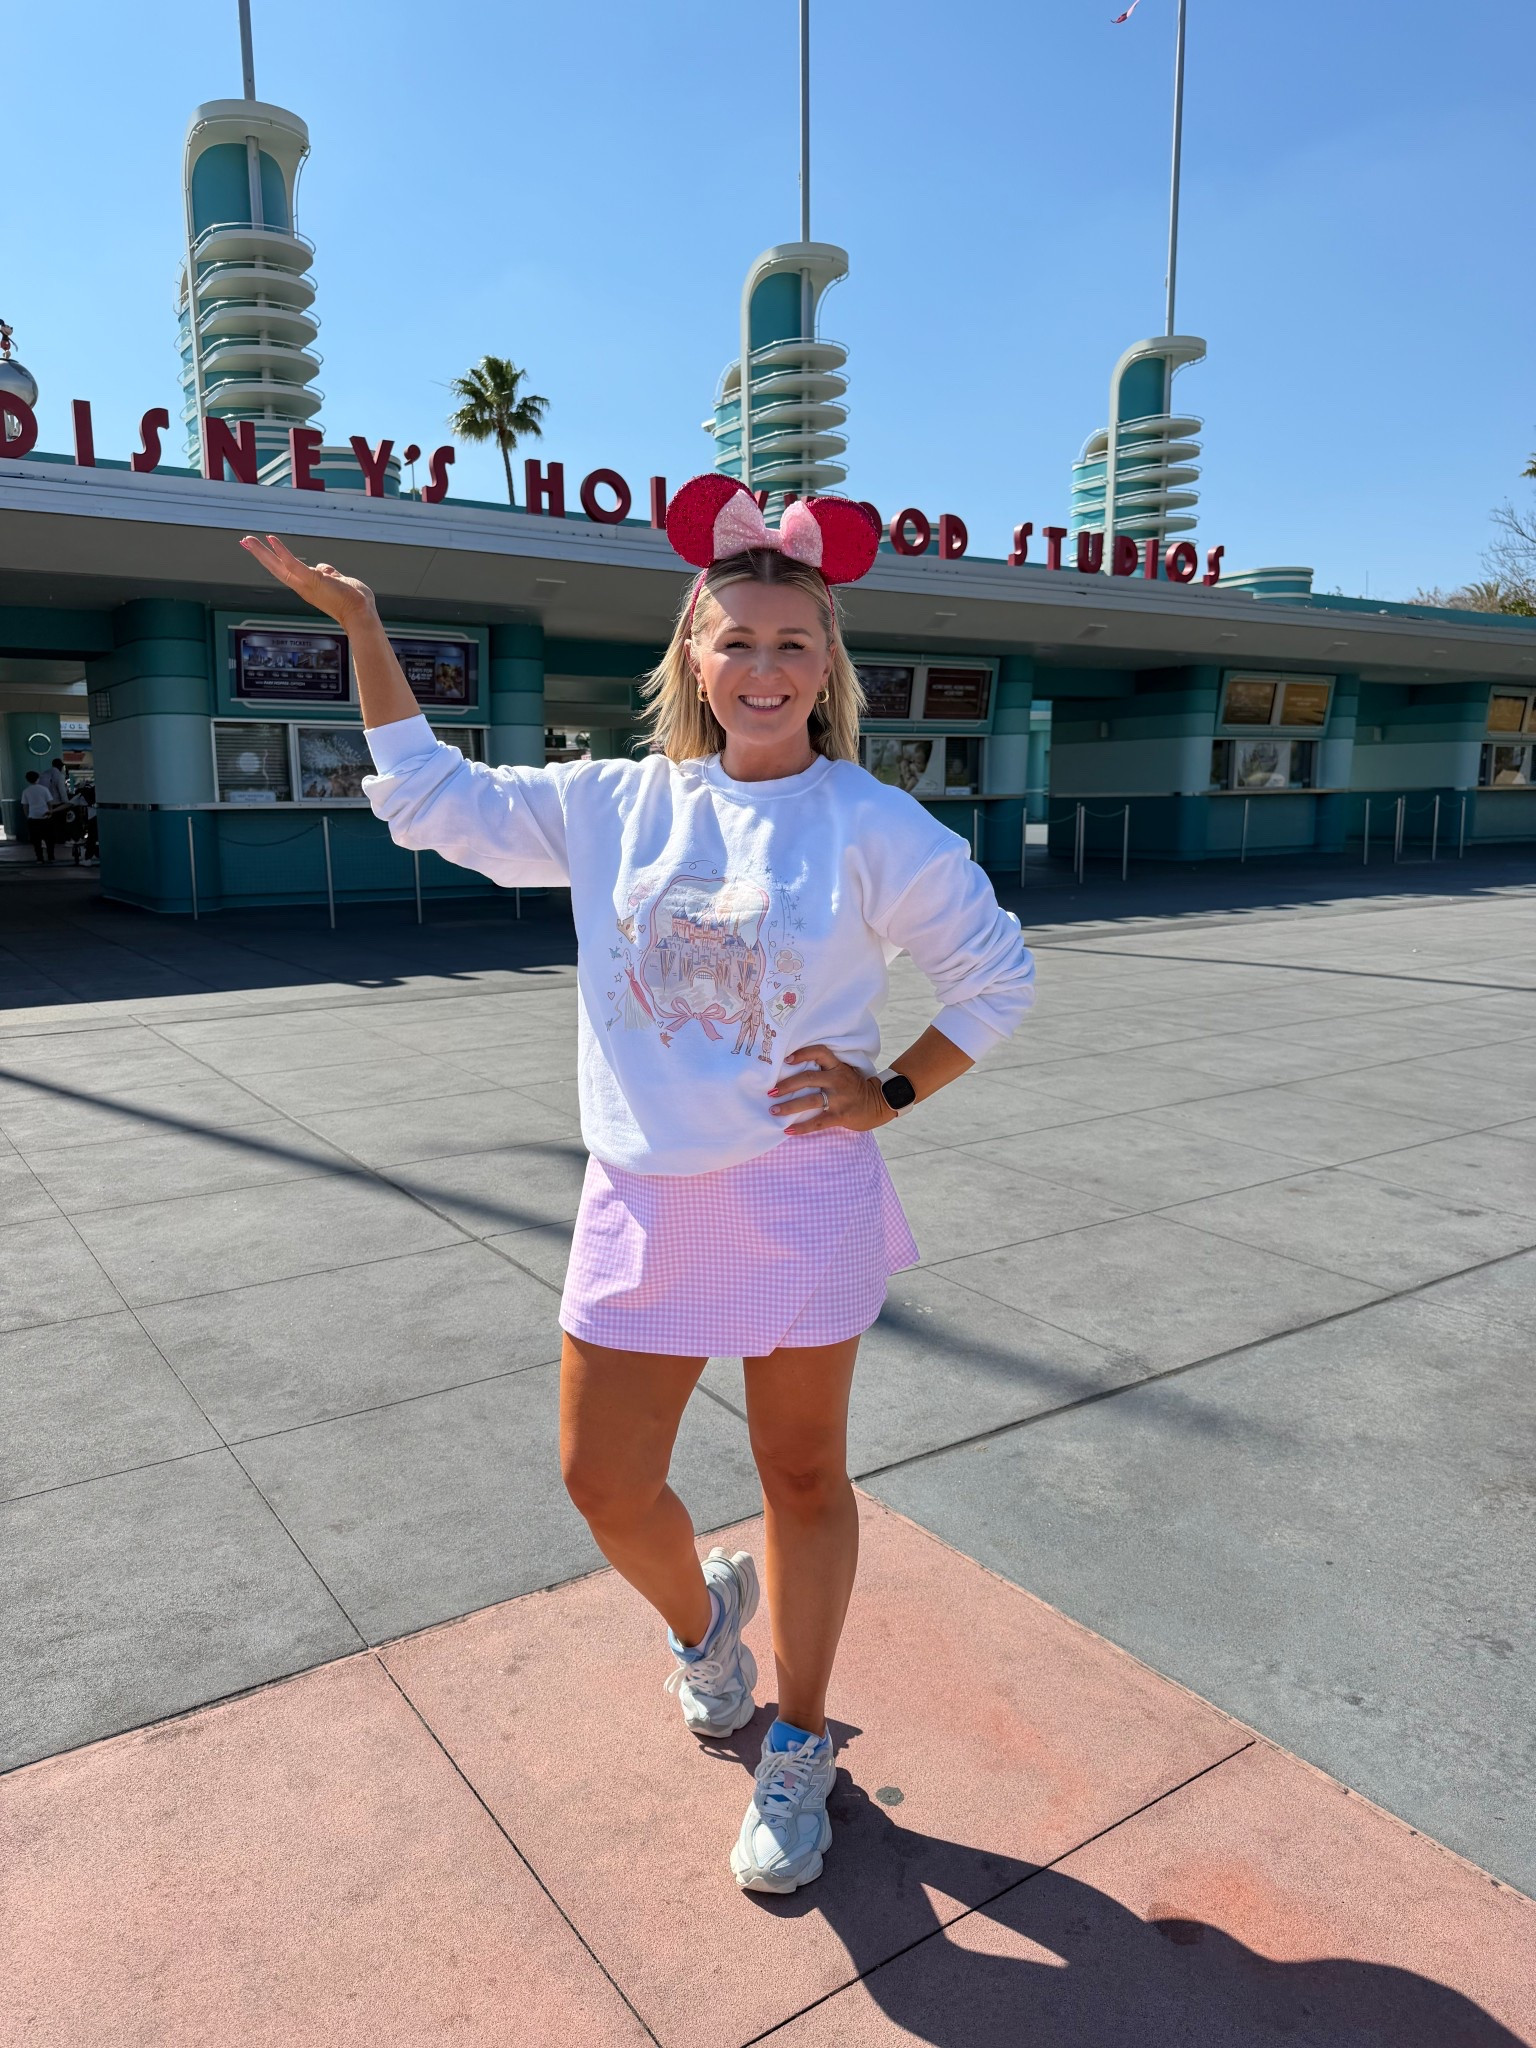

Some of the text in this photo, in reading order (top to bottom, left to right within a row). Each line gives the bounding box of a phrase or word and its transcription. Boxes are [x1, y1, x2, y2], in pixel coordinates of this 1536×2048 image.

[0, 390, 1225, 587] DISNEY'S HOLOD STUDIOS
